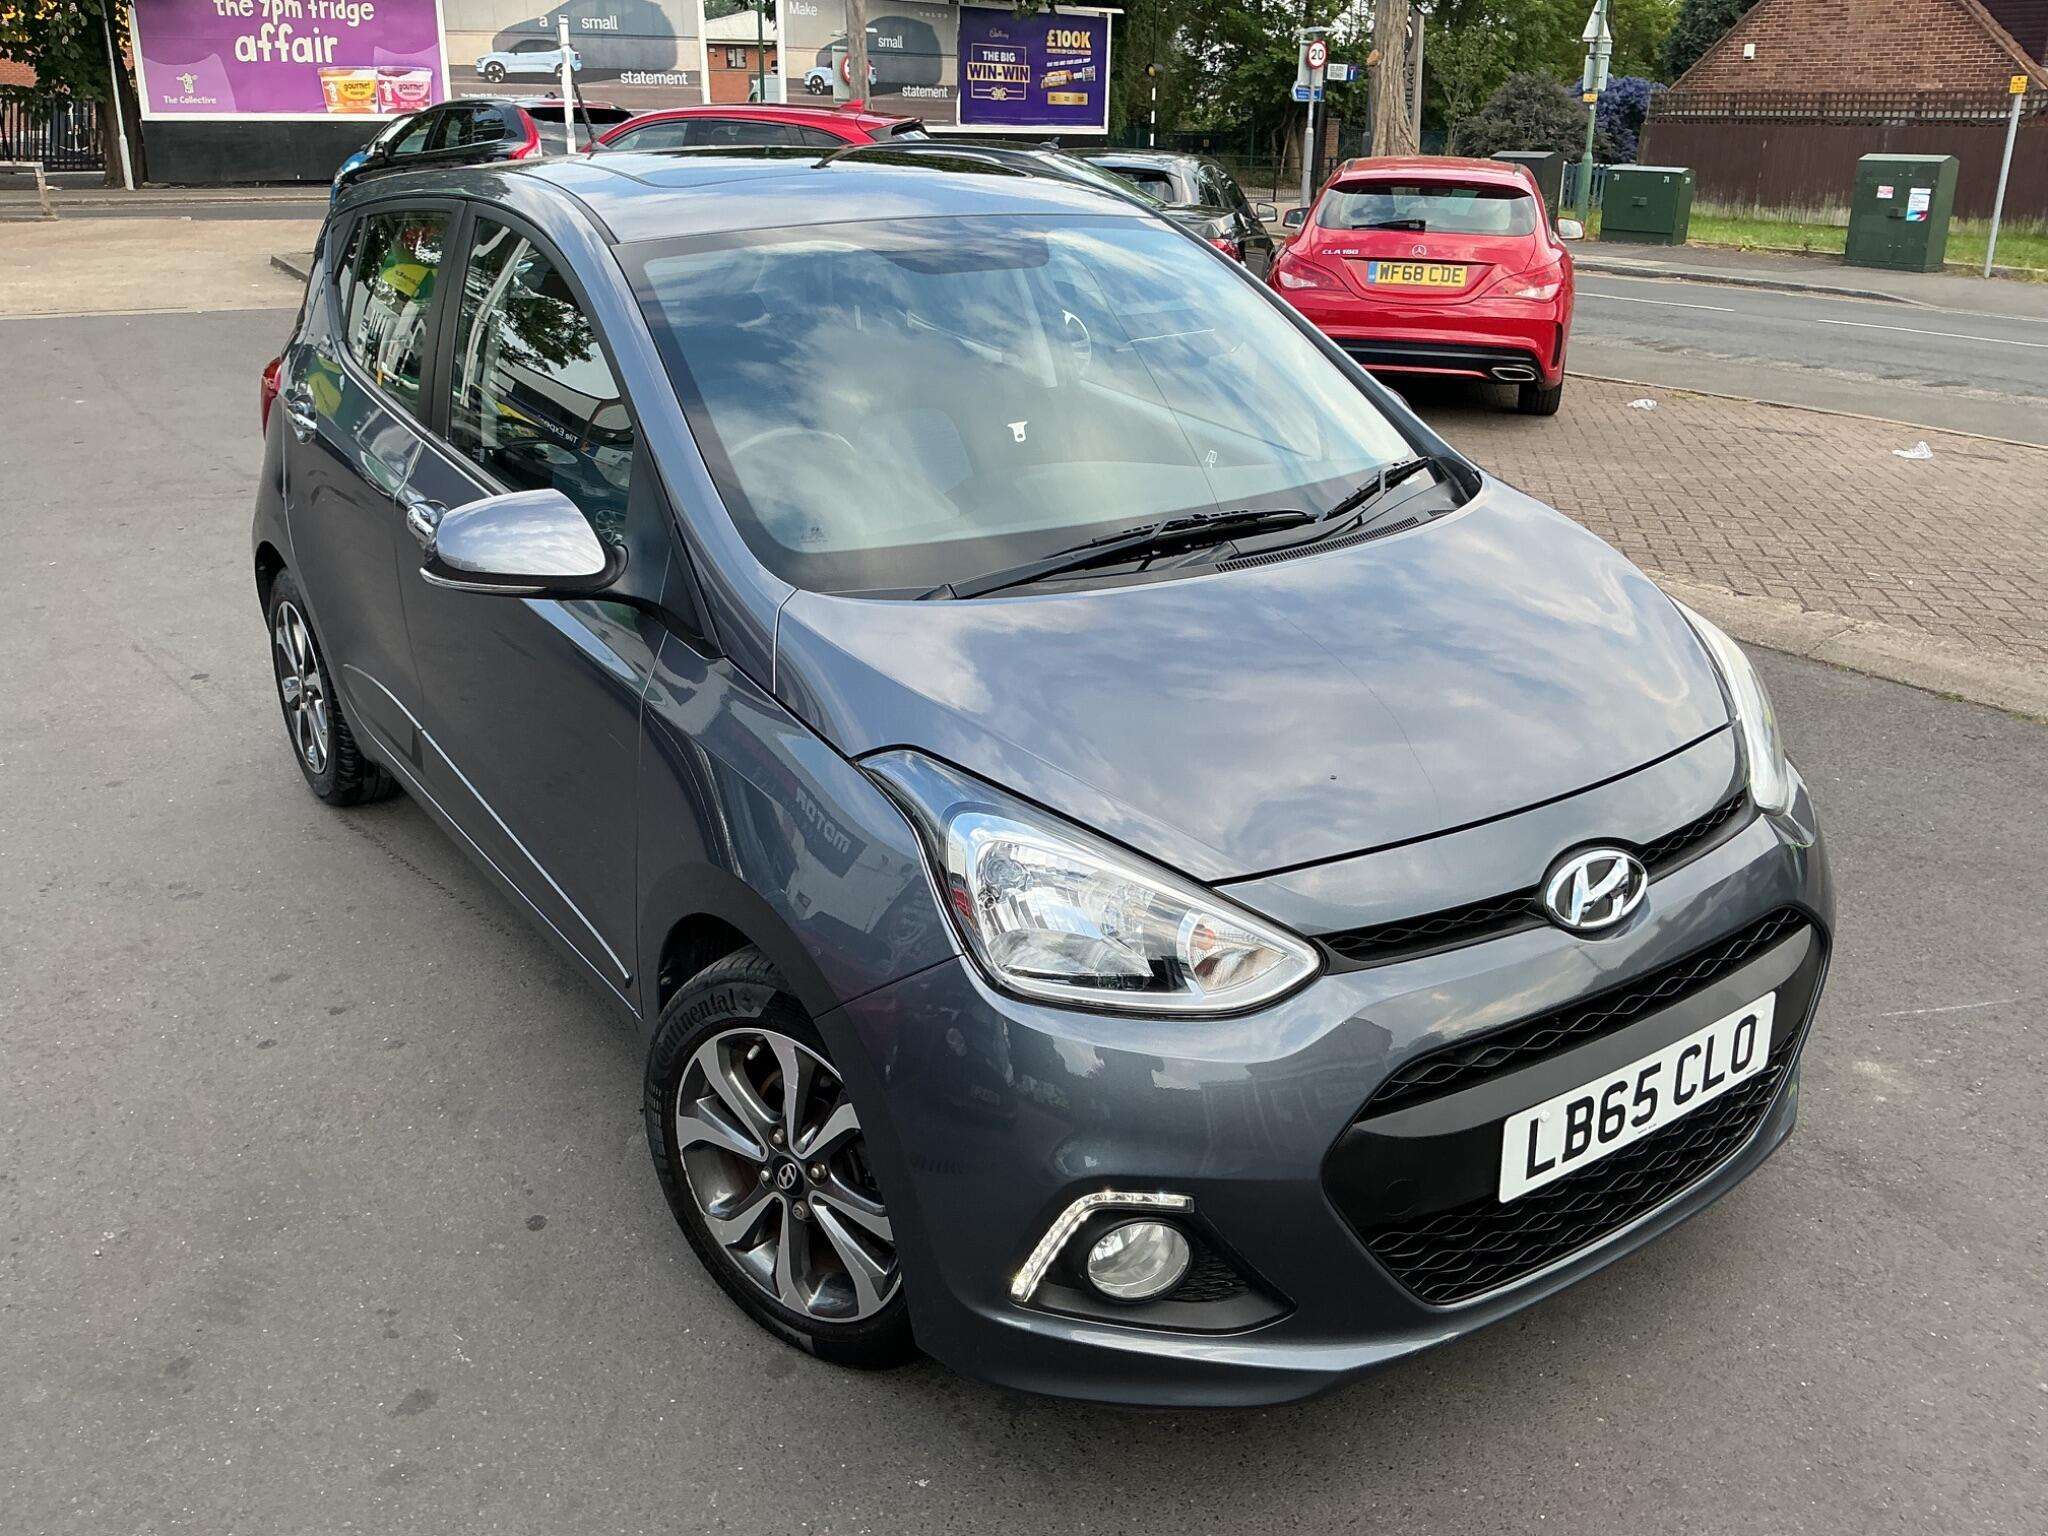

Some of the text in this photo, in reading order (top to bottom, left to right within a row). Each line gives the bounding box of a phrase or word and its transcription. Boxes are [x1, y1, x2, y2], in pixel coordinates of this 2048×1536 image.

[214, 0, 254, 16] the
[307, 0, 374, 27] fridge
[789, 1, 818, 17] Make
[539, 15, 618, 30] a small
[234, 22, 338, 63] affair
[878, 35, 904, 49] small
[1046, 29, 1091, 49] £100K
[982, 50, 1016, 62] THE BIG
[1310, 49, 1325, 60] 20
[620, 71, 688, 85] statement
[968, 64, 1029, 81] WIN-WIN
[901, 84, 948, 98] statement
[1379, 264, 1464, 283] WF68 CDE
[1525, 1013, 1757, 1181] LB65 CLO
